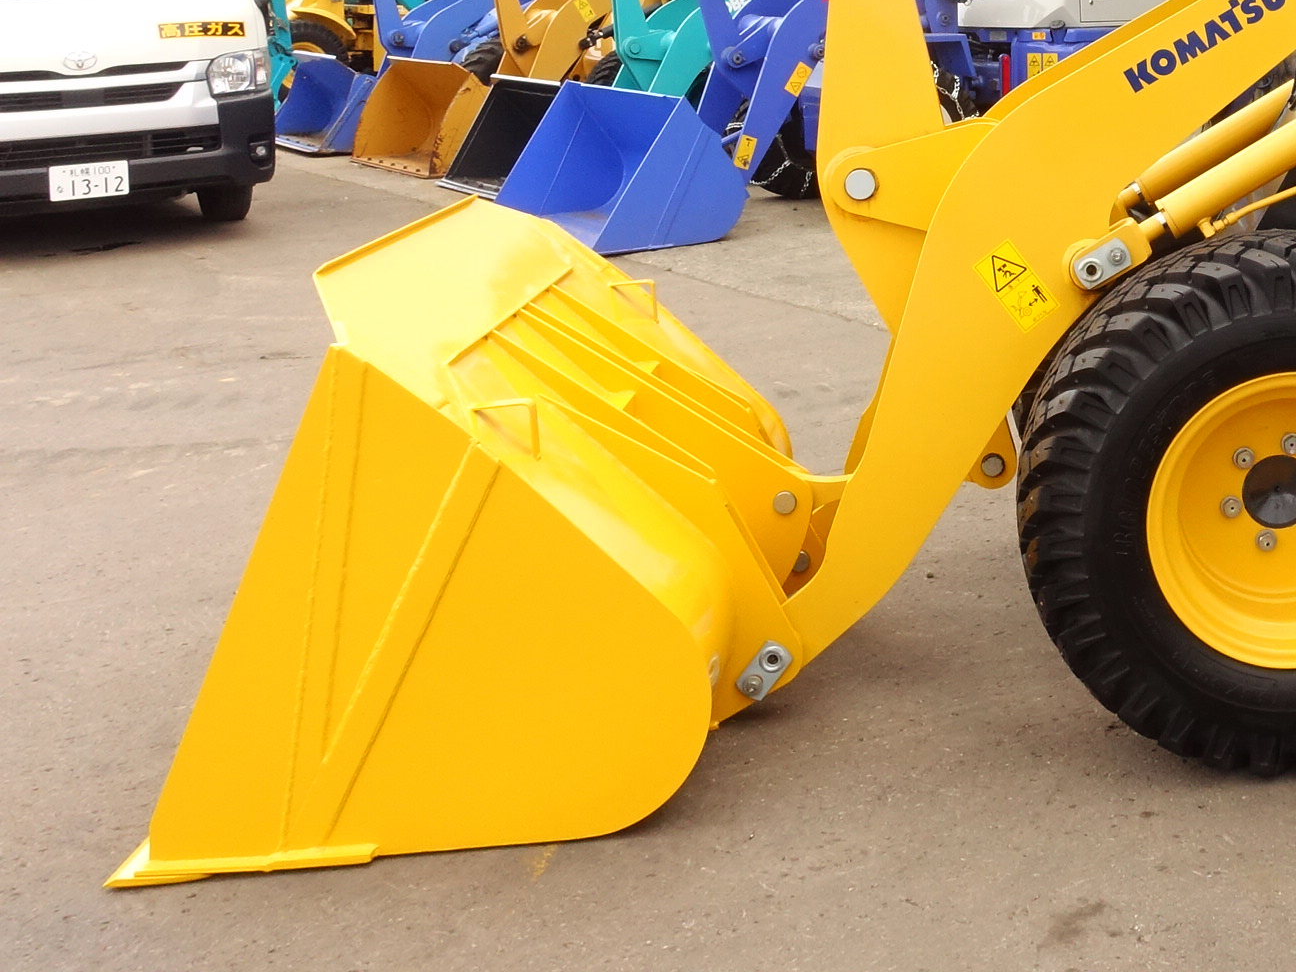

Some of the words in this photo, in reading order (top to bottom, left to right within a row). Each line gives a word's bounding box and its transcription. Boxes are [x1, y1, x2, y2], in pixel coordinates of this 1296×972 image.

[160, 22, 243, 37] 高圧ガス
[71, 176, 124, 196] 13-12
